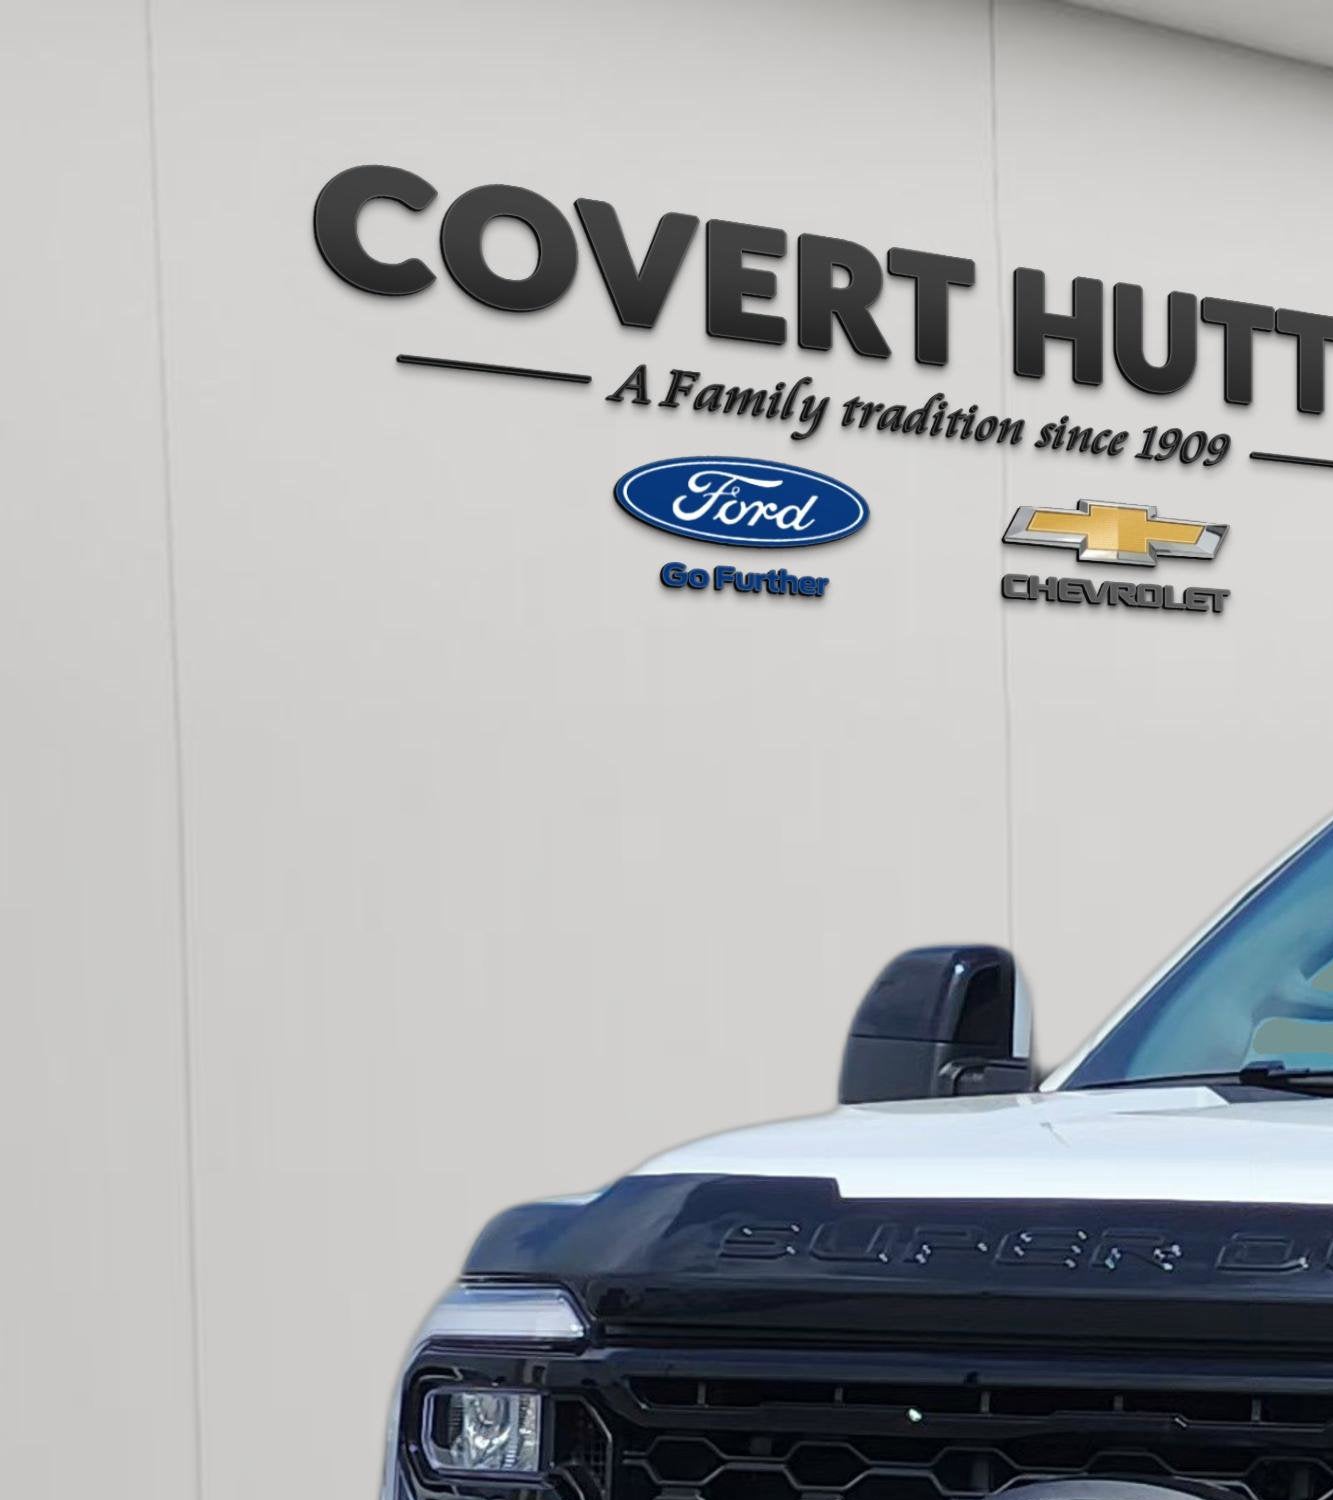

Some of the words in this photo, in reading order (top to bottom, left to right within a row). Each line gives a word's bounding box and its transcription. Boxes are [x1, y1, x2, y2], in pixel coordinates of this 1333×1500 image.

[314, 164, 975, 364] COVERT
[605, 364, 651, 405] A
[658, 369, 831, 440] Family
[841, 393, 1025, 445] tradition
[1034, 416, 1129, 457] since
[1135, 426, 1231, 467] 1909
[672, 470, 819, 531] Ford
[660, 562, 710, 590] Go
[714, 566, 829, 596] Further
[1001, 573, 1231, 613] CHEVROLET
[719, 1223, 1181, 1272] SUPER
